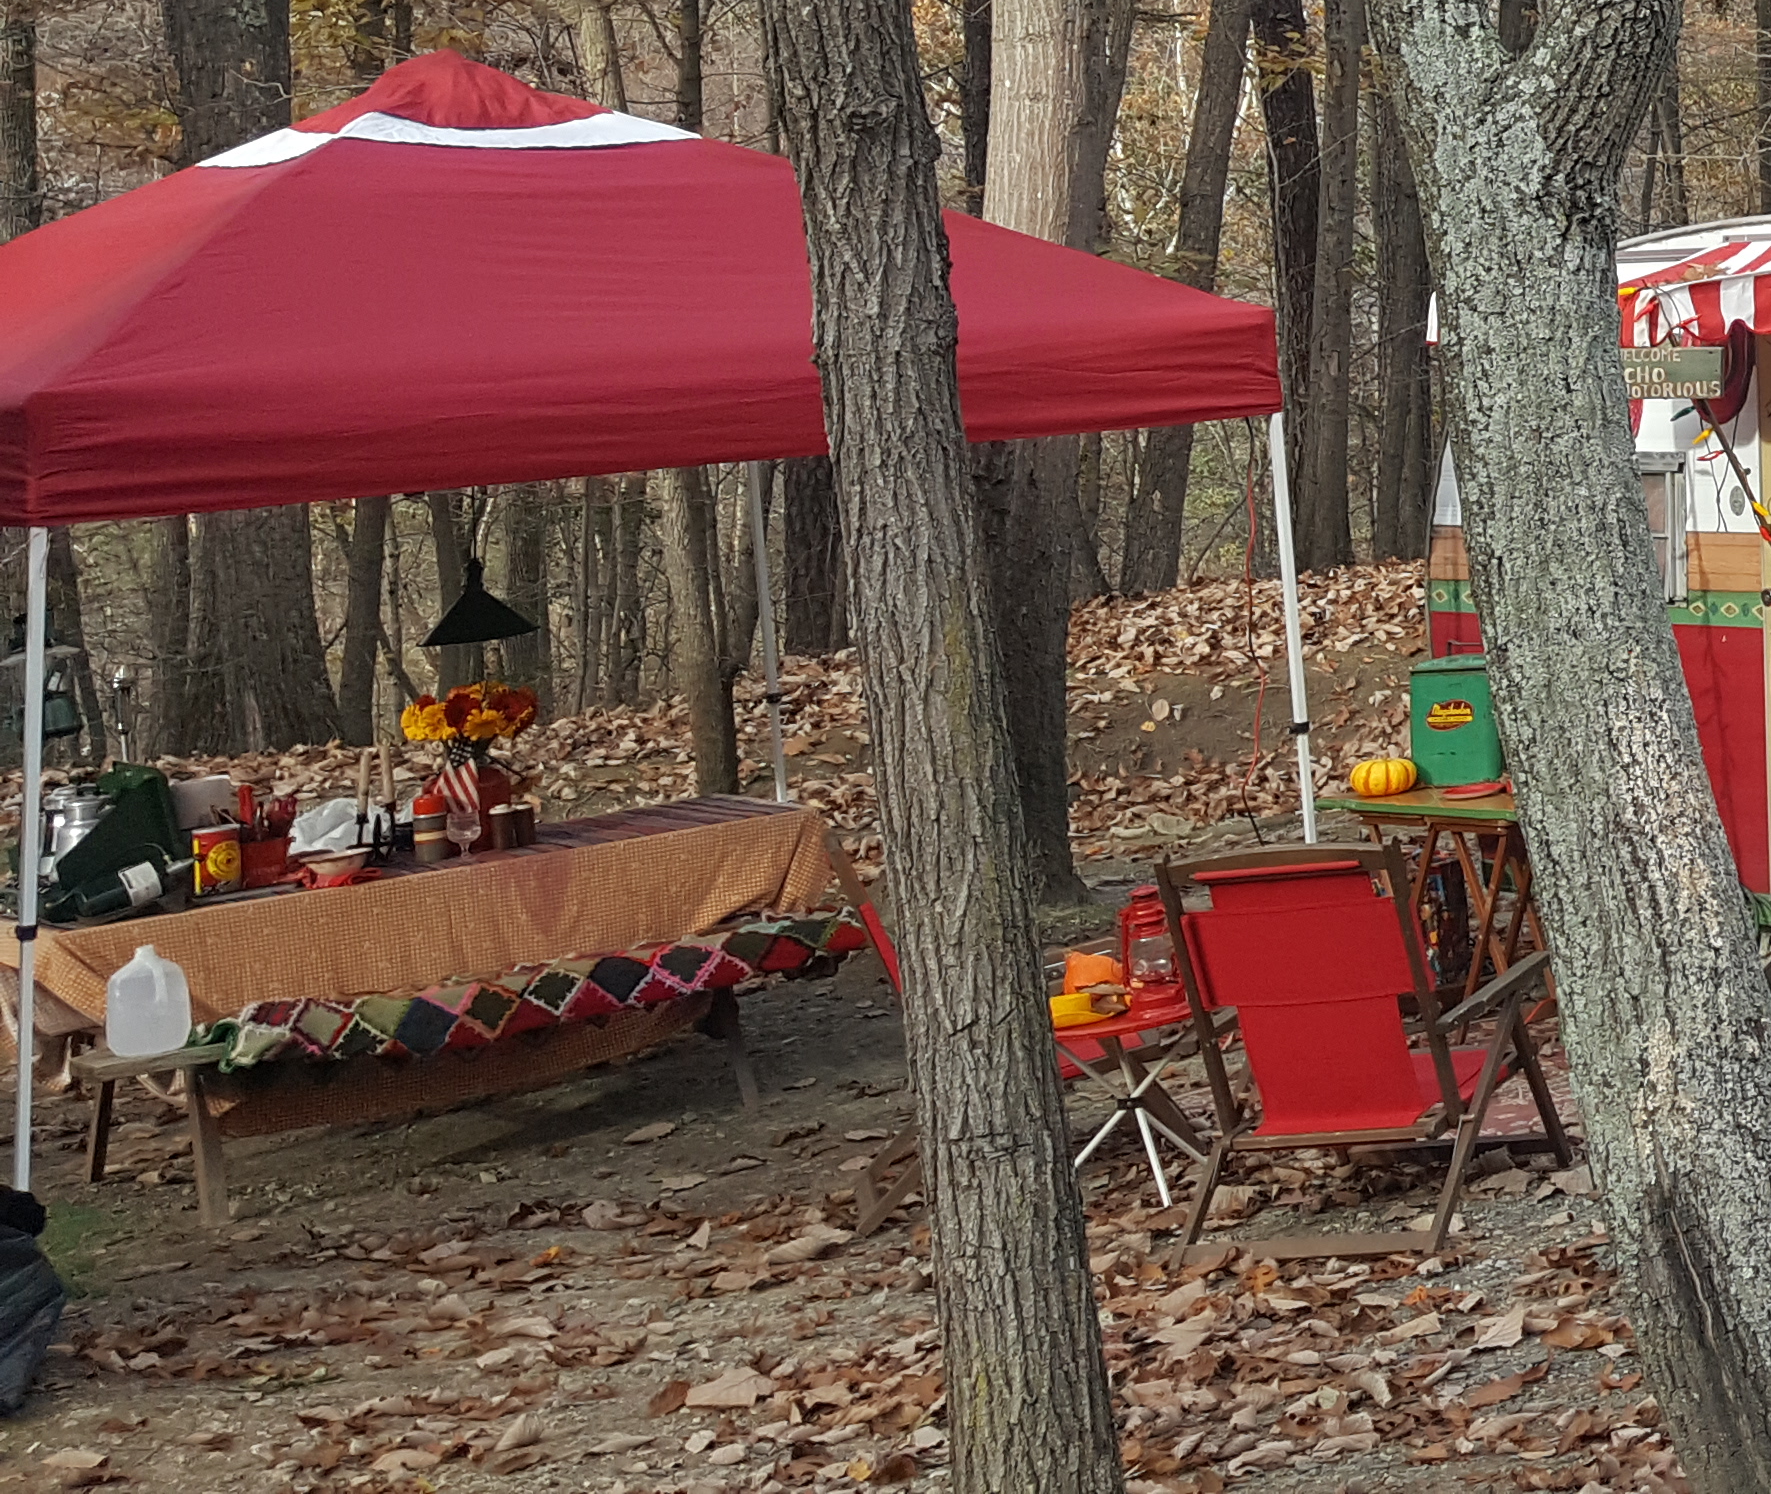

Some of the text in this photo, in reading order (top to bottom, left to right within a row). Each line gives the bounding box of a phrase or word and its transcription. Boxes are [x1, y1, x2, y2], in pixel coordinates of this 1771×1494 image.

[1620, 348, 1681, 363] ELCOME
[1623, 365, 1666, 384] CHO
[1627, 380, 1721, 399] OTORIOUS
